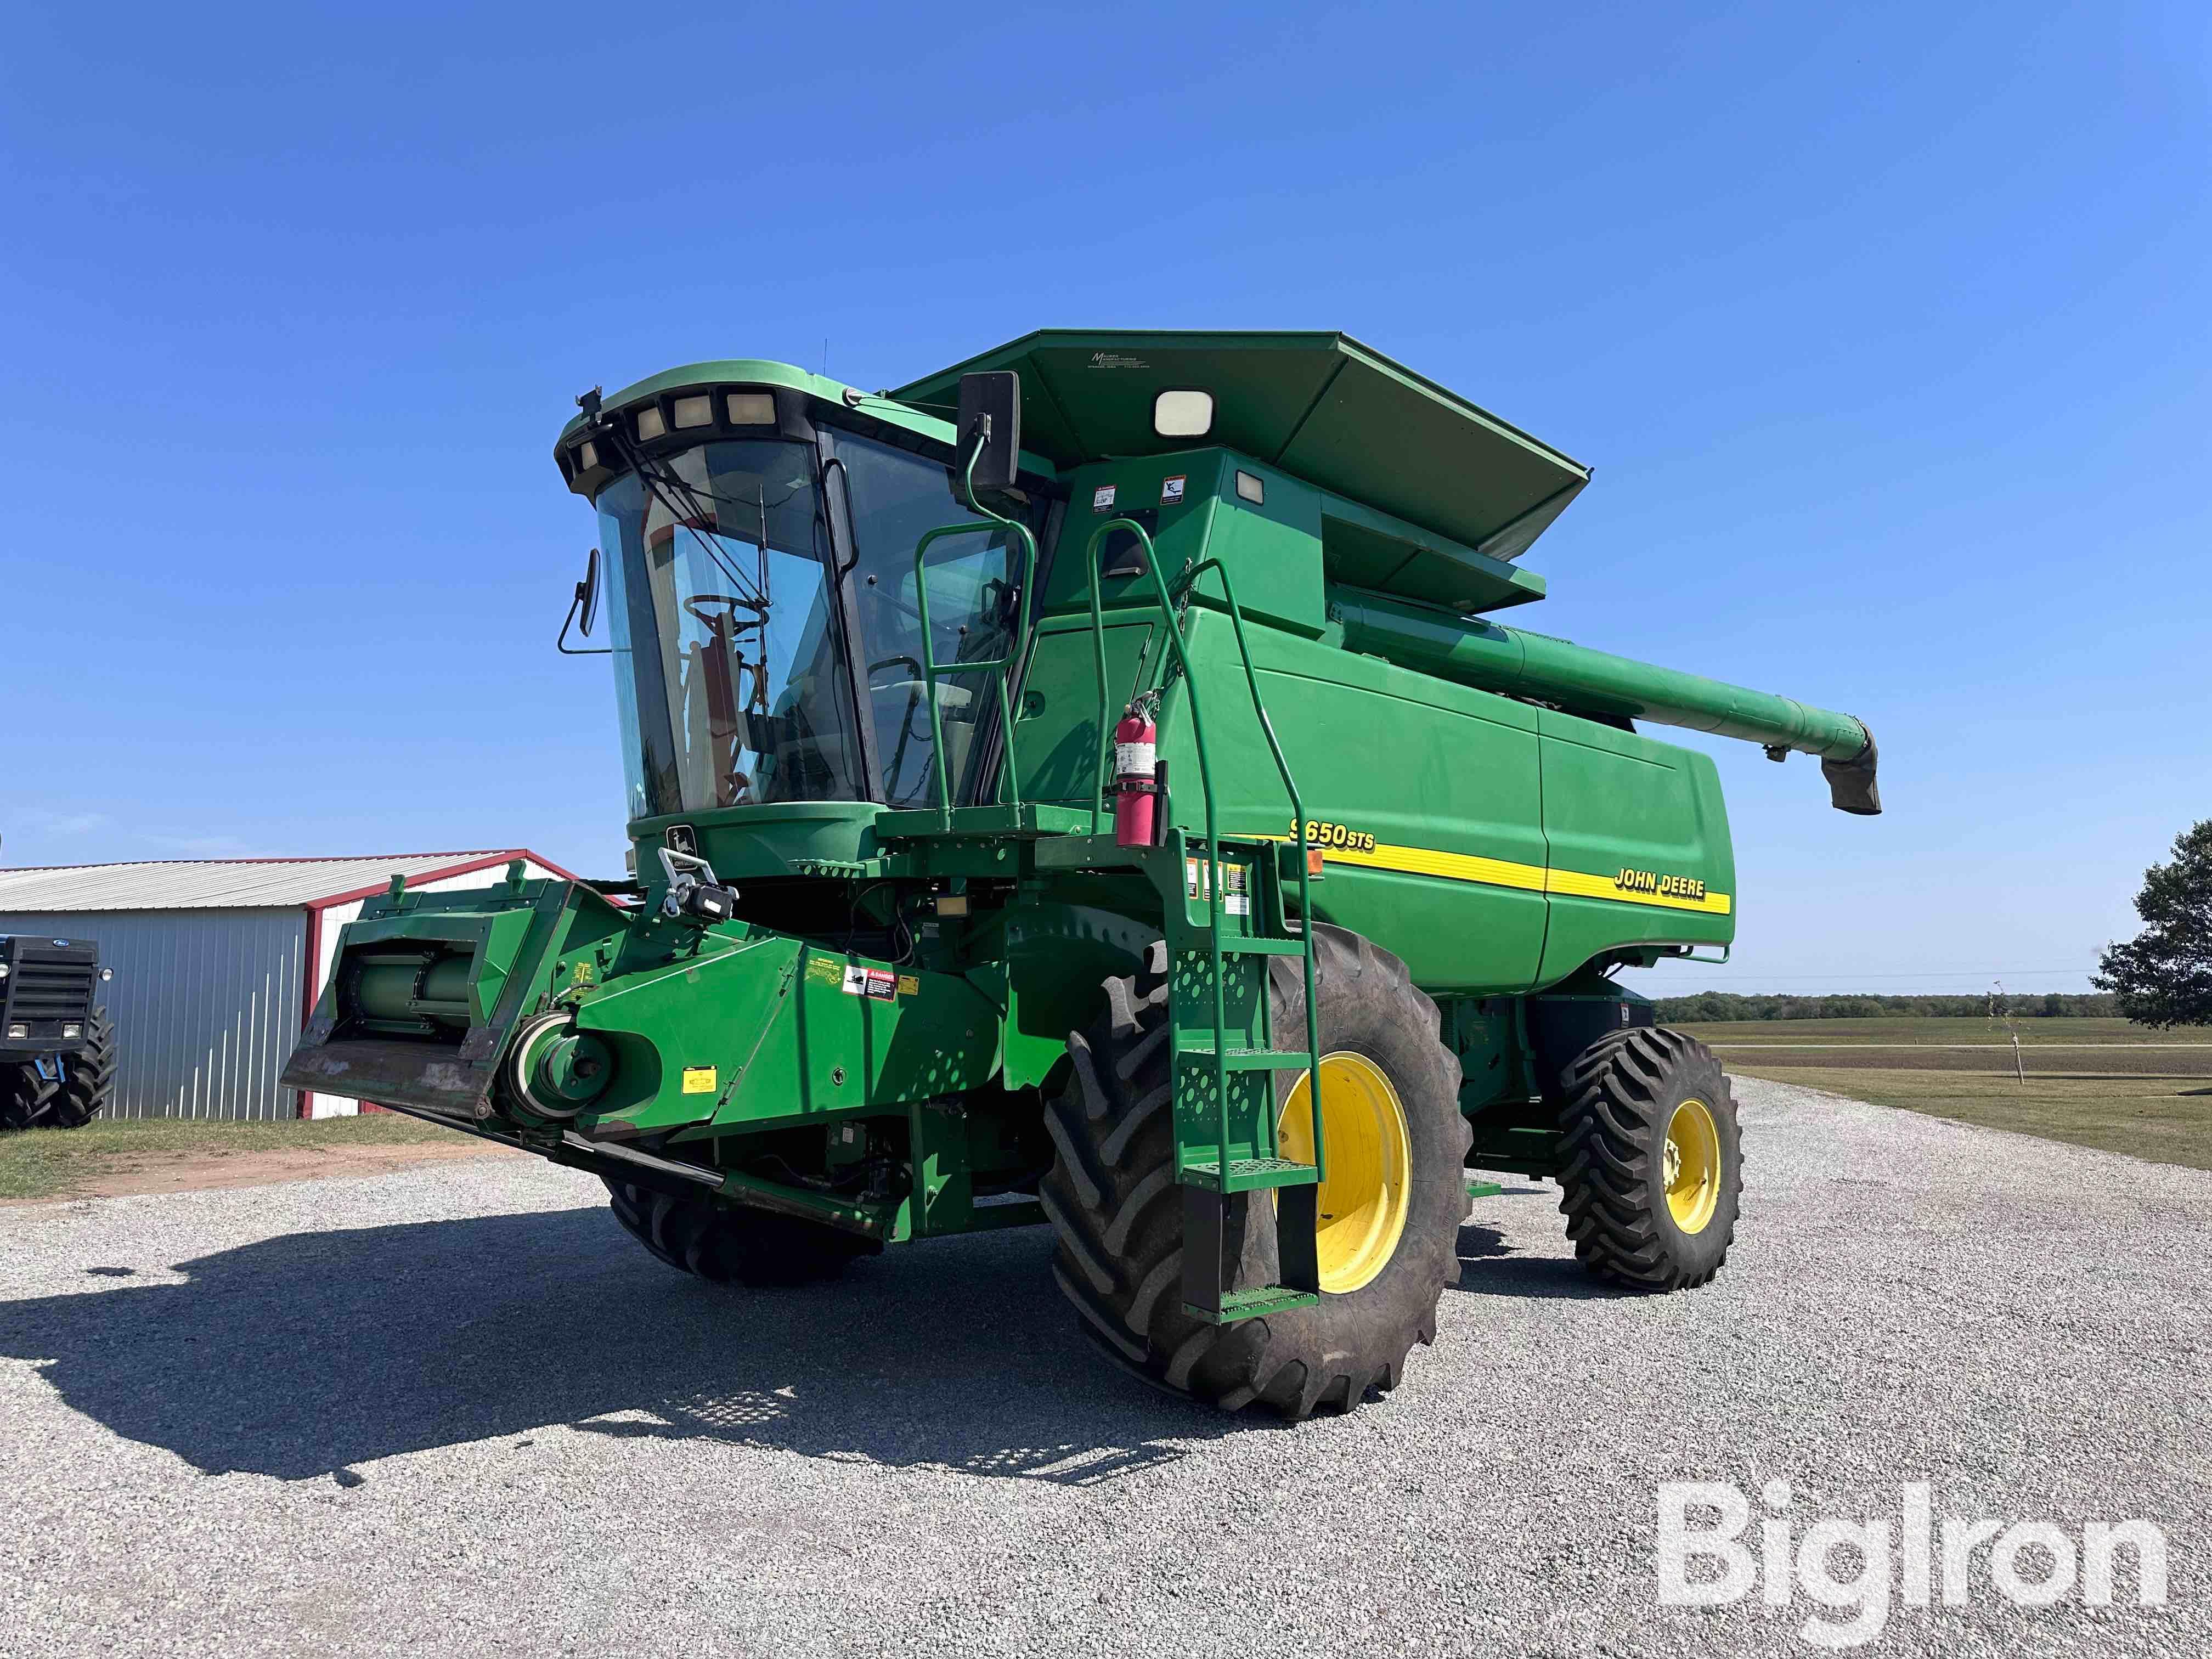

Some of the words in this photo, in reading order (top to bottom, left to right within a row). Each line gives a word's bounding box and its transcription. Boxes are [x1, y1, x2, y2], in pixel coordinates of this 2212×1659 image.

[1613, 868, 1657, 892] JOHN
[1660, 874, 1705, 900] DEERE
[875, 972, 895, 980] DANGER
